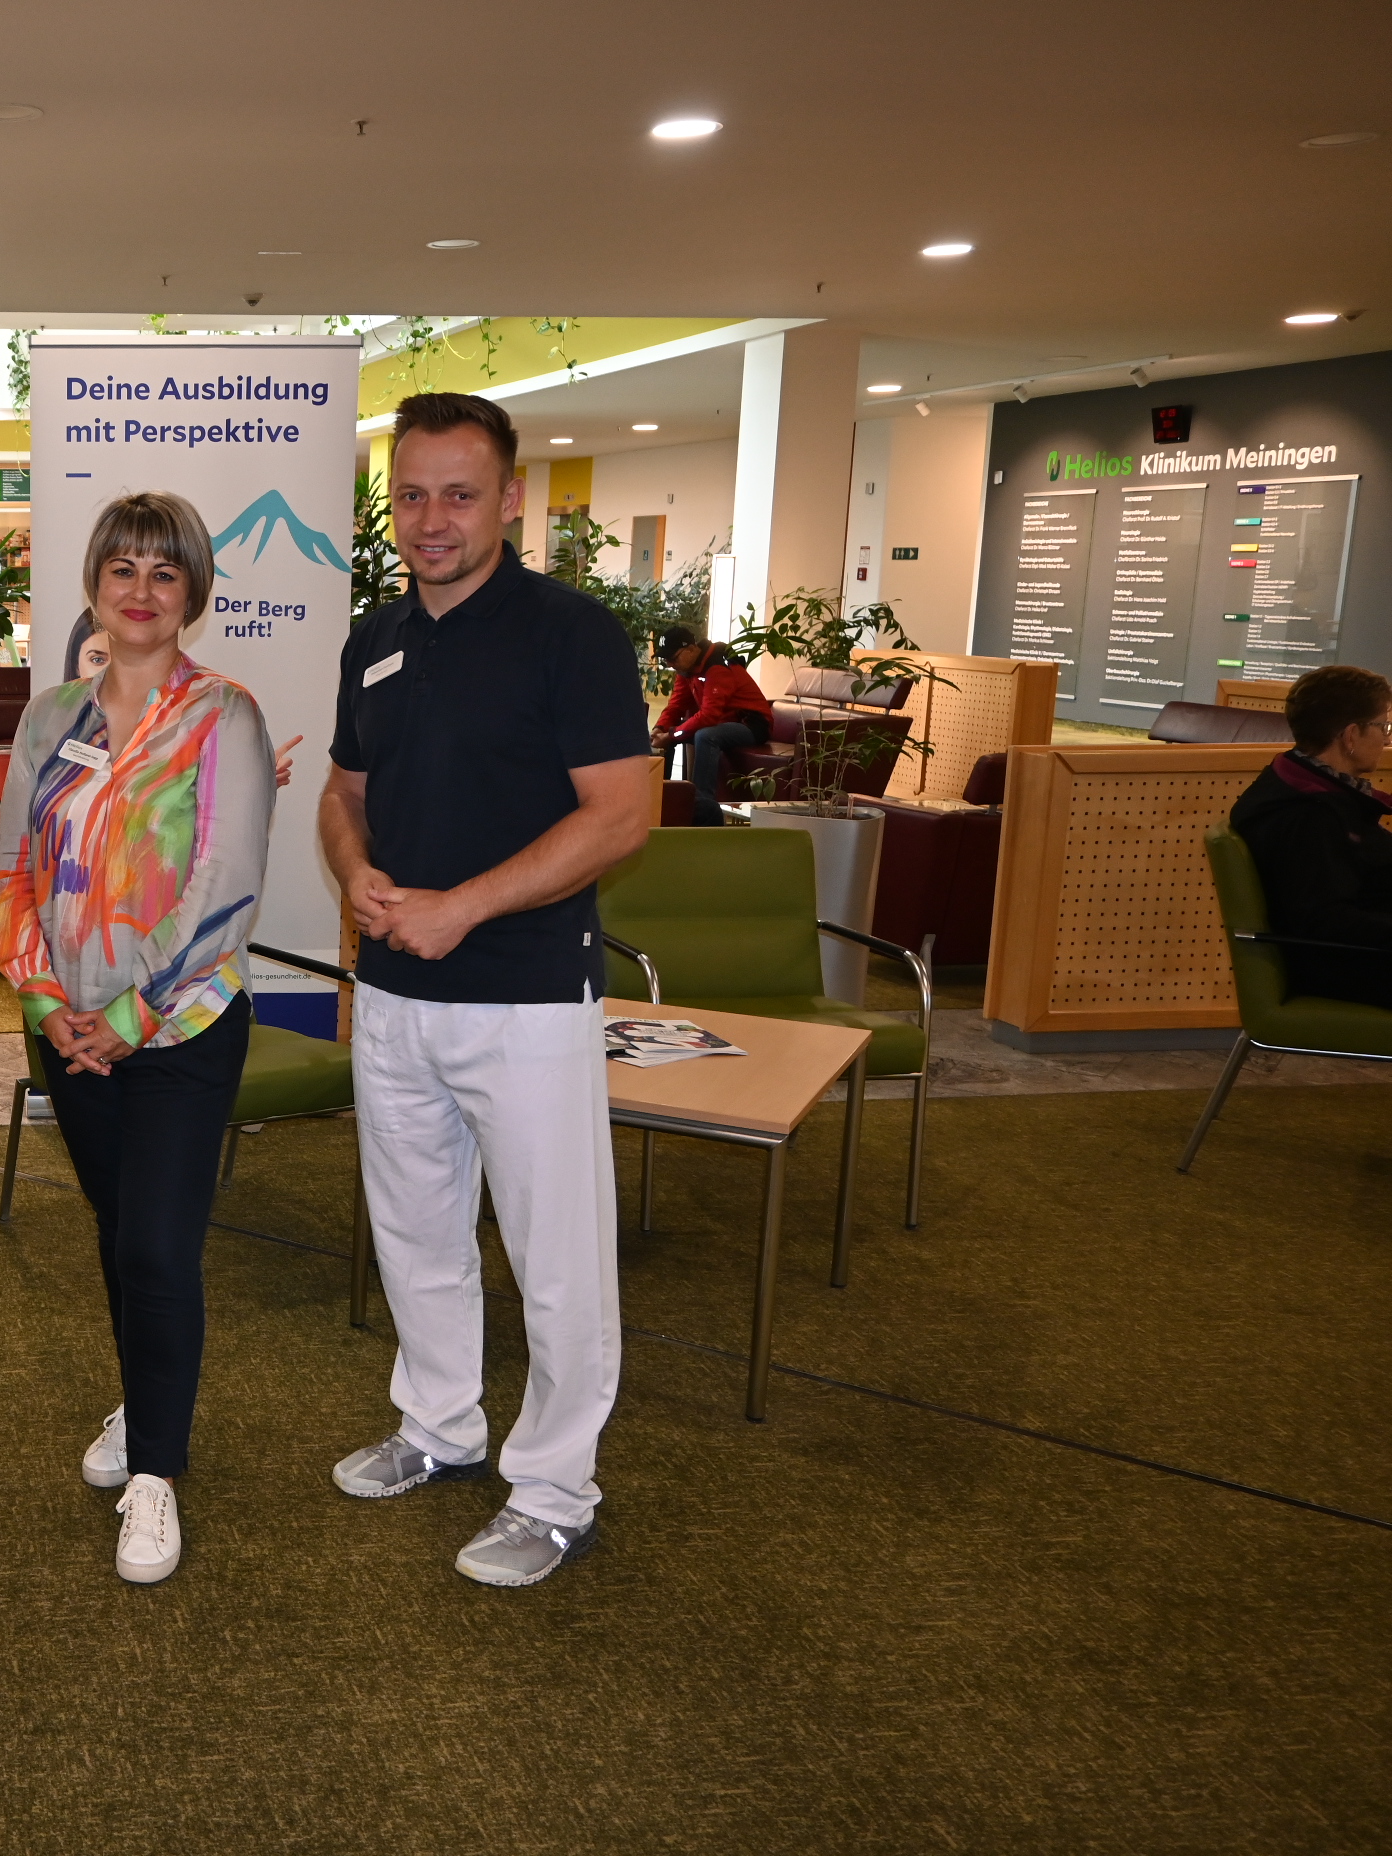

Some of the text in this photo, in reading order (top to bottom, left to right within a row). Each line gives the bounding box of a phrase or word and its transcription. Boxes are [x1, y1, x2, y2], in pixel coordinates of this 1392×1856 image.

[66, 375, 329, 406] Deine Ausbildung
[66, 417, 300, 448] mit Perspektive
[1064, 442, 1337, 479] Helios Klinikum Meiningen
[214, 596, 306, 621] Der Berg
[224, 621, 272, 638] ruft!
